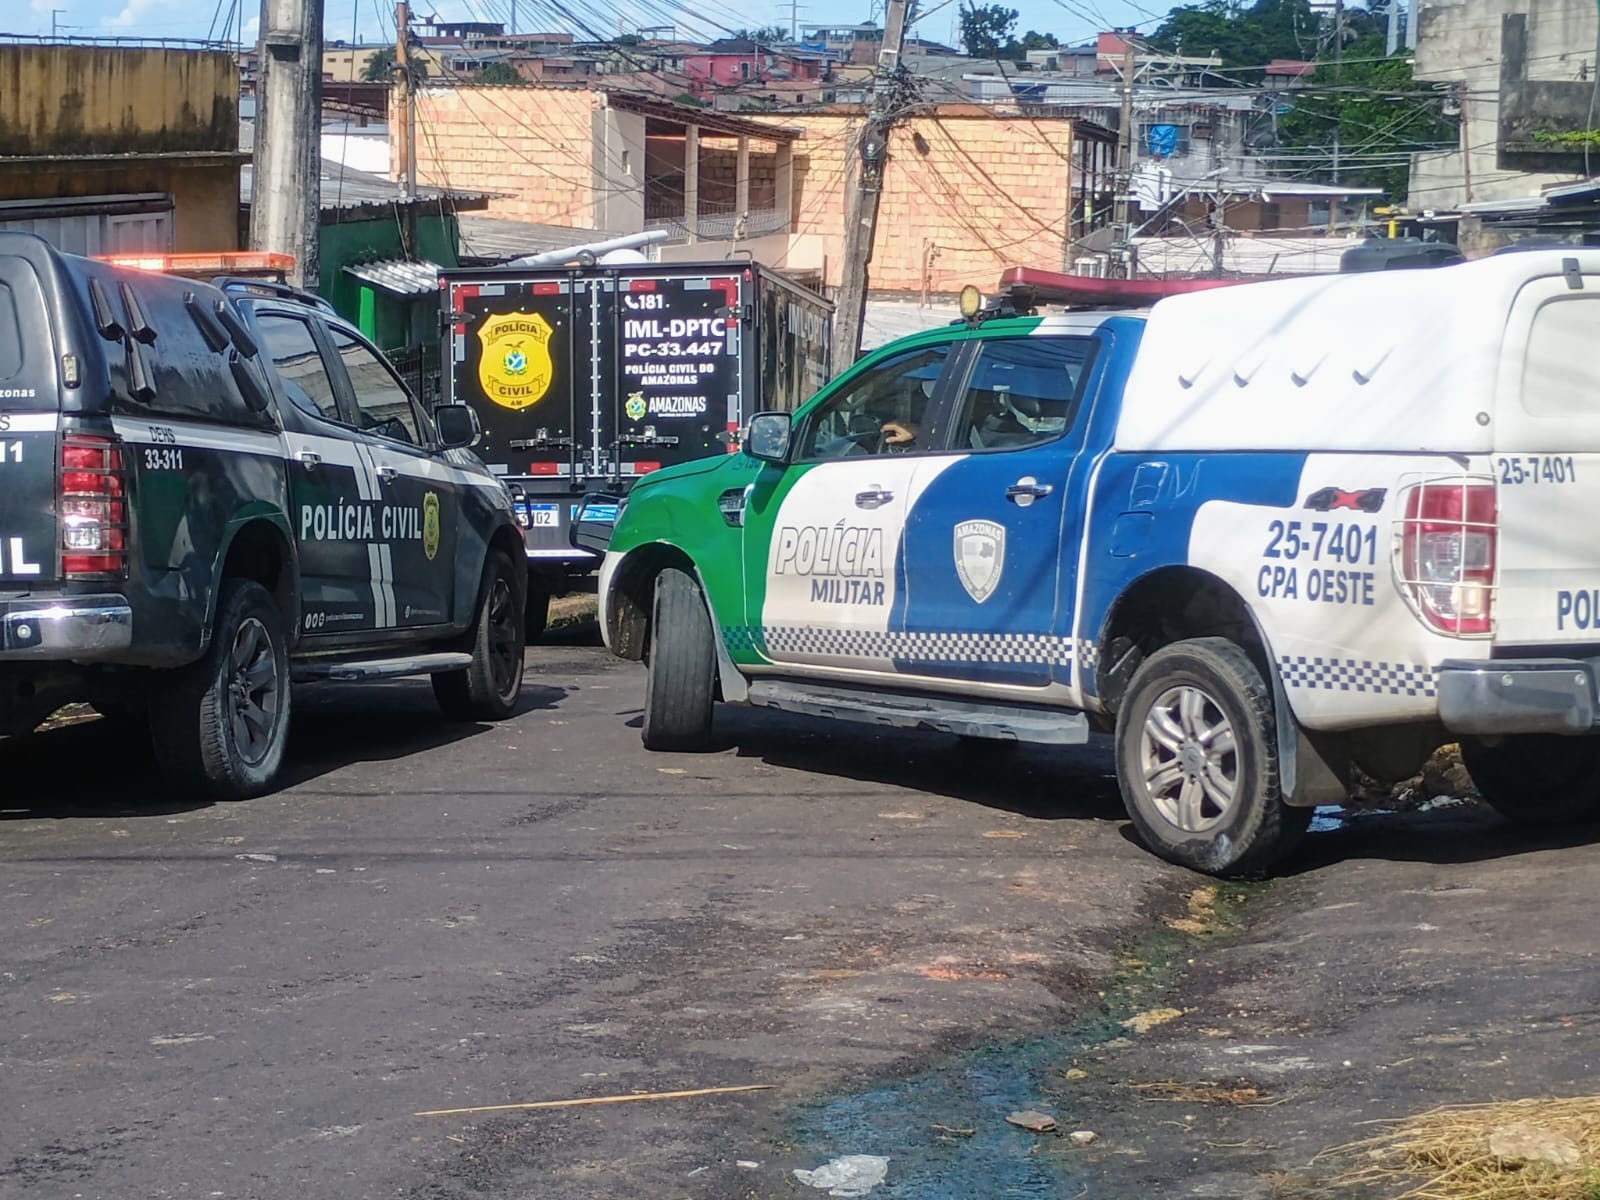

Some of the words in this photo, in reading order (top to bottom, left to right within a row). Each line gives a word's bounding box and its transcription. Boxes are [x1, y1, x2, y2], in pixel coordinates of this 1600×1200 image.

[638, 294, 663, 309] 181
[495, 322, 538, 335] POLÍCIA
[625, 318, 725, 339] IML-DPTC
[625, 342, 723, 357] PC-33.447
[625, 362, 666, 375] POLÍCIA
[669, 364, 697, 374] CIVIL
[699, 363, 715, 373] DO
[499, 386, 533, 395] CIVIL
[641, 375, 698, 385] AMAZONAS
[648, 396, 707, 413] AMAZONAS
[145, 448, 183, 470] 33-311
[1498, 456, 1576, 485] 25-7401
[300, 496, 374, 541] POLÍCIA
[381, 505, 422, 540] CIVIL
[775, 517, 884, 578] POLÍCIA
[1262, 519, 1377, 565] 25-7401
[0, 537, 40, 574] L
[810, 578, 885, 606] MILITAR
[1257, 565, 1298, 600] CPA
[1306, 568, 1375, 606] OESTE
